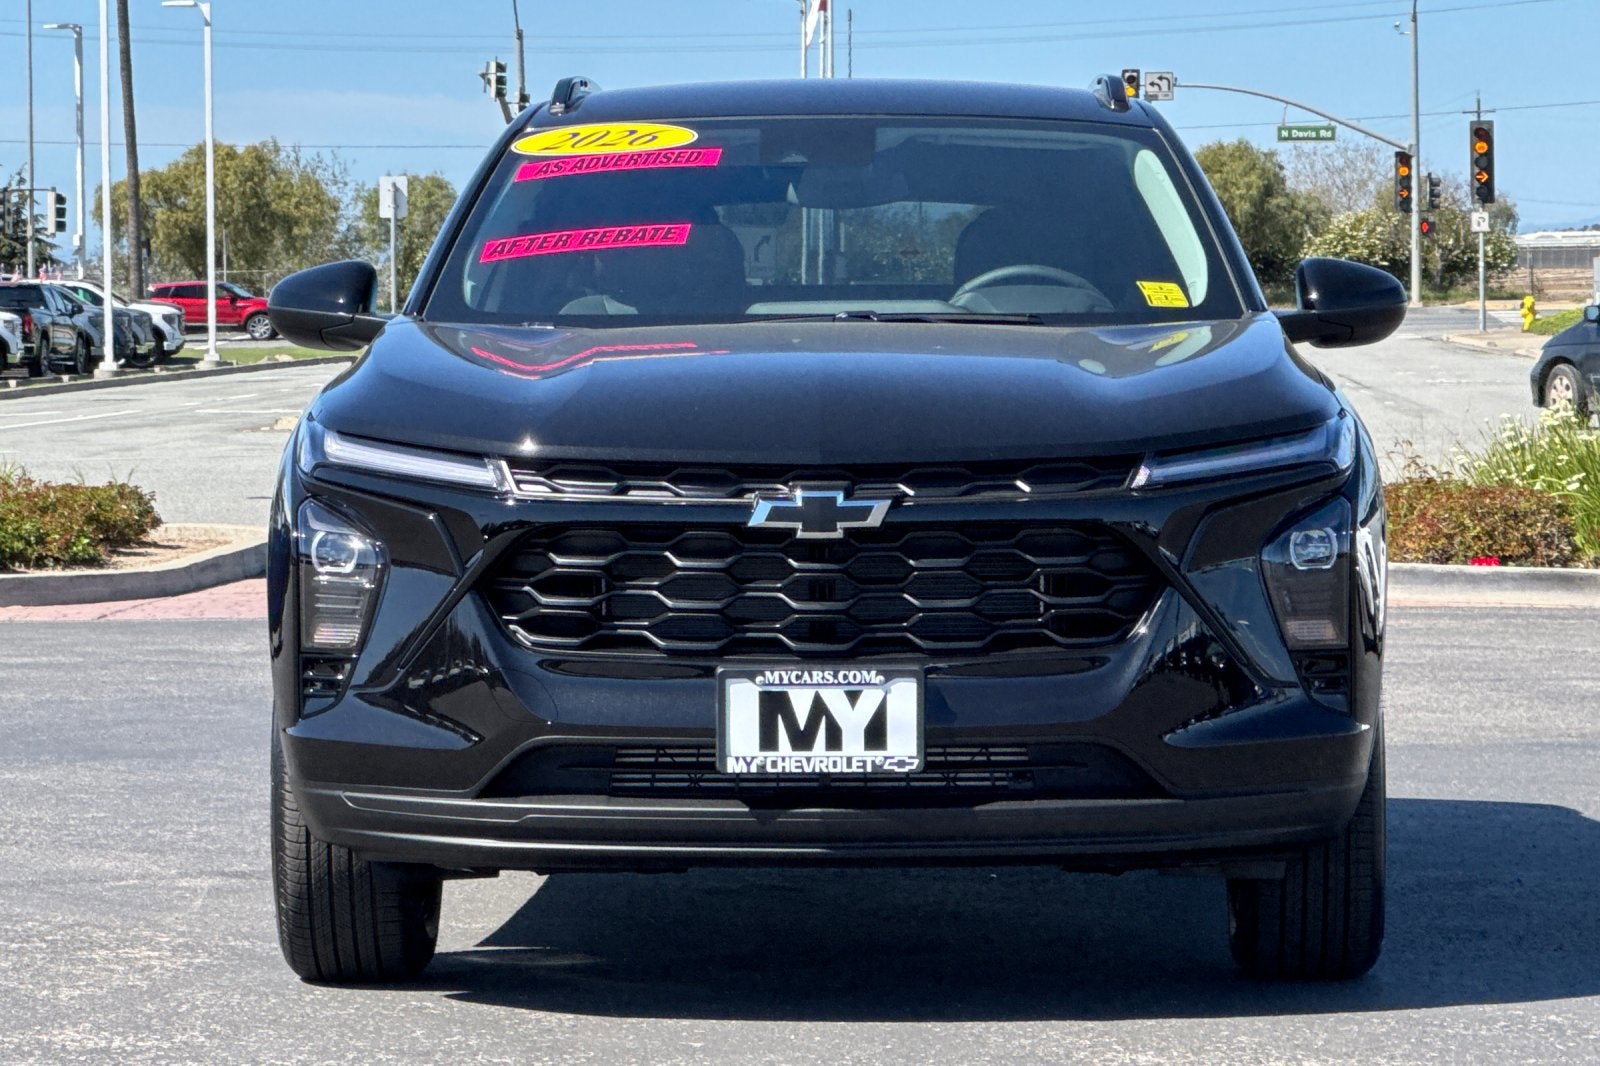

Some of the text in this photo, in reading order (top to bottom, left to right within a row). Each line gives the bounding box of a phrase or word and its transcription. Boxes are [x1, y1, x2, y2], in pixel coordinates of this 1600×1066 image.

[542, 129, 672, 151] 2026
[1281, 129, 1332, 138] N Davis Rd
[535, 150, 703, 176] AS ADVERTISED
[489, 227, 678, 256] AFTER REBATE
[763, 670, 877, 685] MYCARS.COM
[758, 690, 888, 752] MY
[726, 756, 873, 774] MY CHEVROLET
